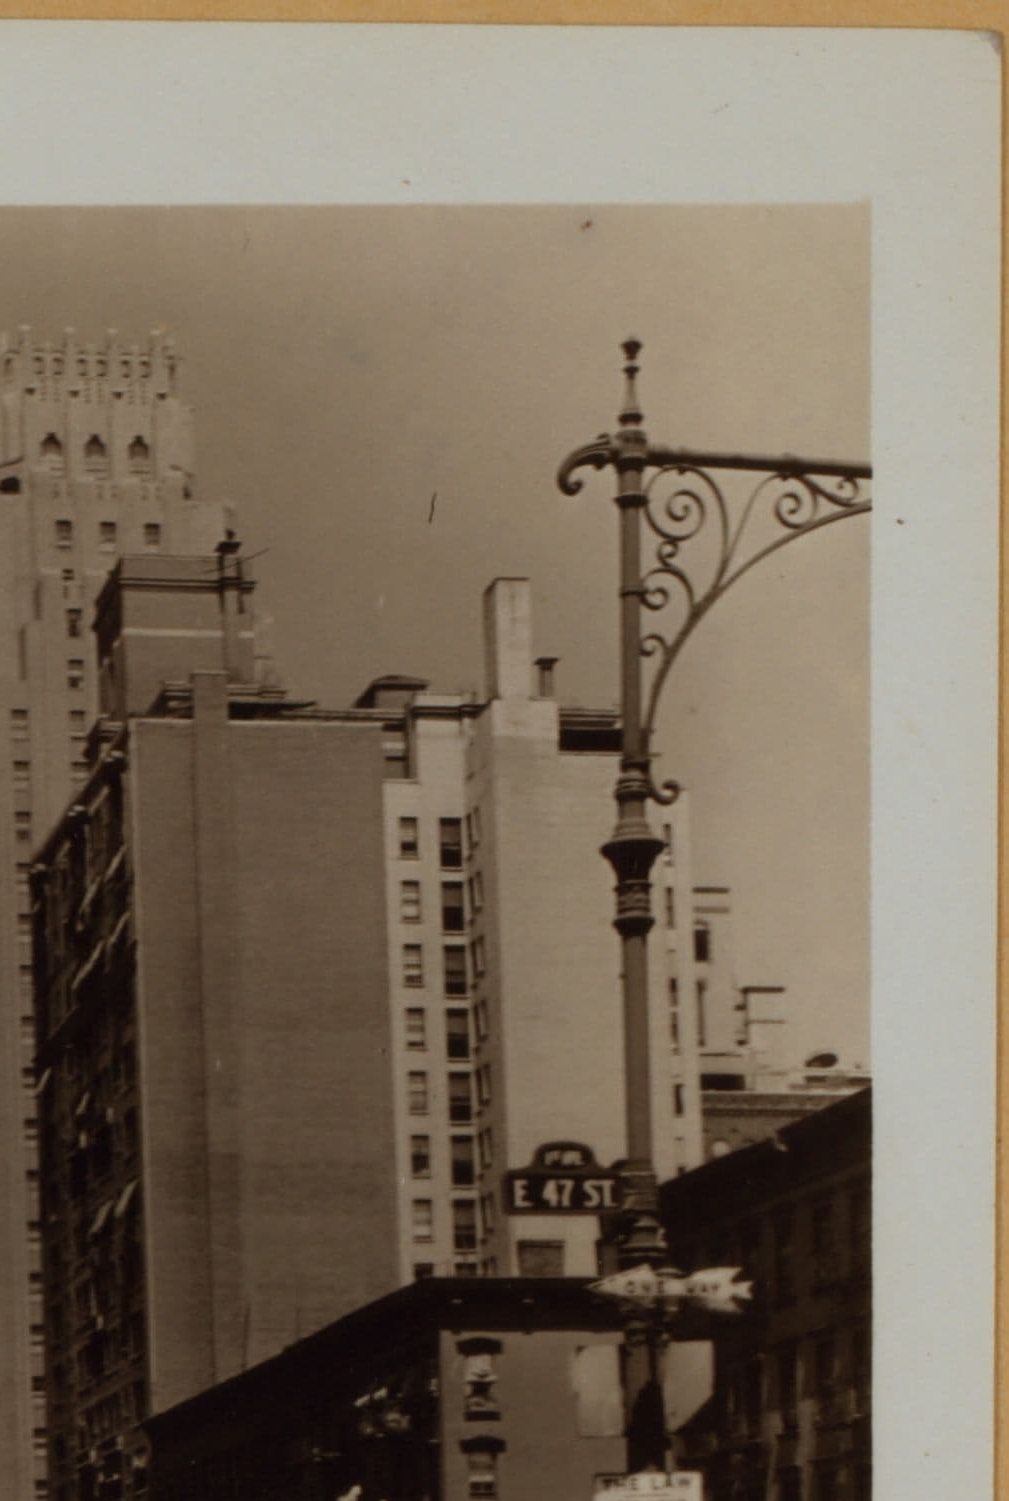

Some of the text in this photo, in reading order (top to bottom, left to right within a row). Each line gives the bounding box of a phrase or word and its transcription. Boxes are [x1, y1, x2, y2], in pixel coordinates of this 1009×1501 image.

[541, 1178, 575, 1208] 47
[625, 1279, 721, 1295] ONE WAY
